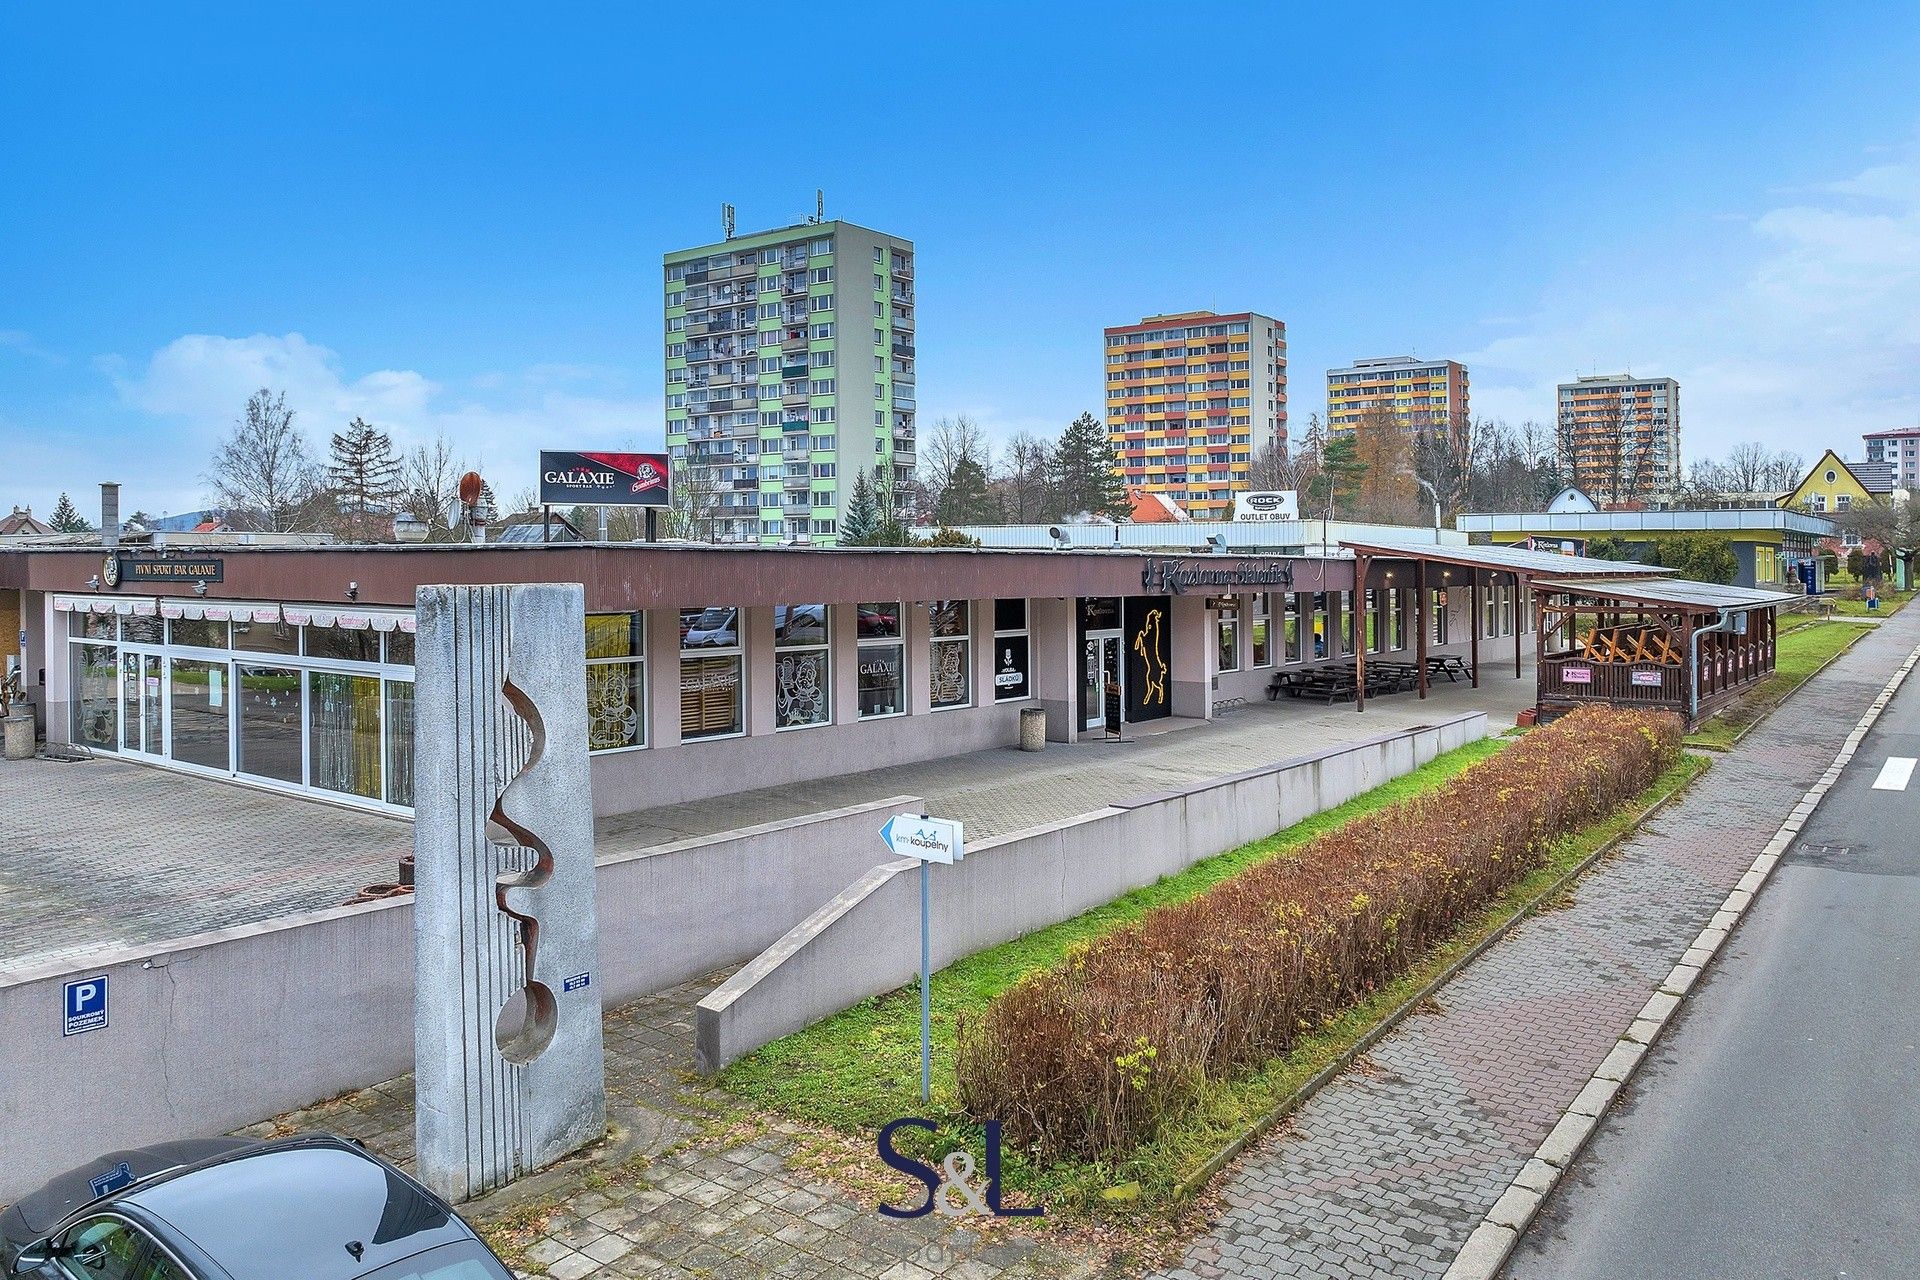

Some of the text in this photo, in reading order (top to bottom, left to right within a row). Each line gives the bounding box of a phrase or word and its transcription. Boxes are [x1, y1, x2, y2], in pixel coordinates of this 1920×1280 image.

[544, 471, 615, 485] GALAXIE
[1240, 513, 1268, 521] OUTLET
[153, 564, 172, 575] SPORT
[174, 564, 188, 575] BAR
[188, 564, 216, 576] GALAXIE
[910, 836, 949, 853] koupelny
[76, 984, 96, 1012] P
